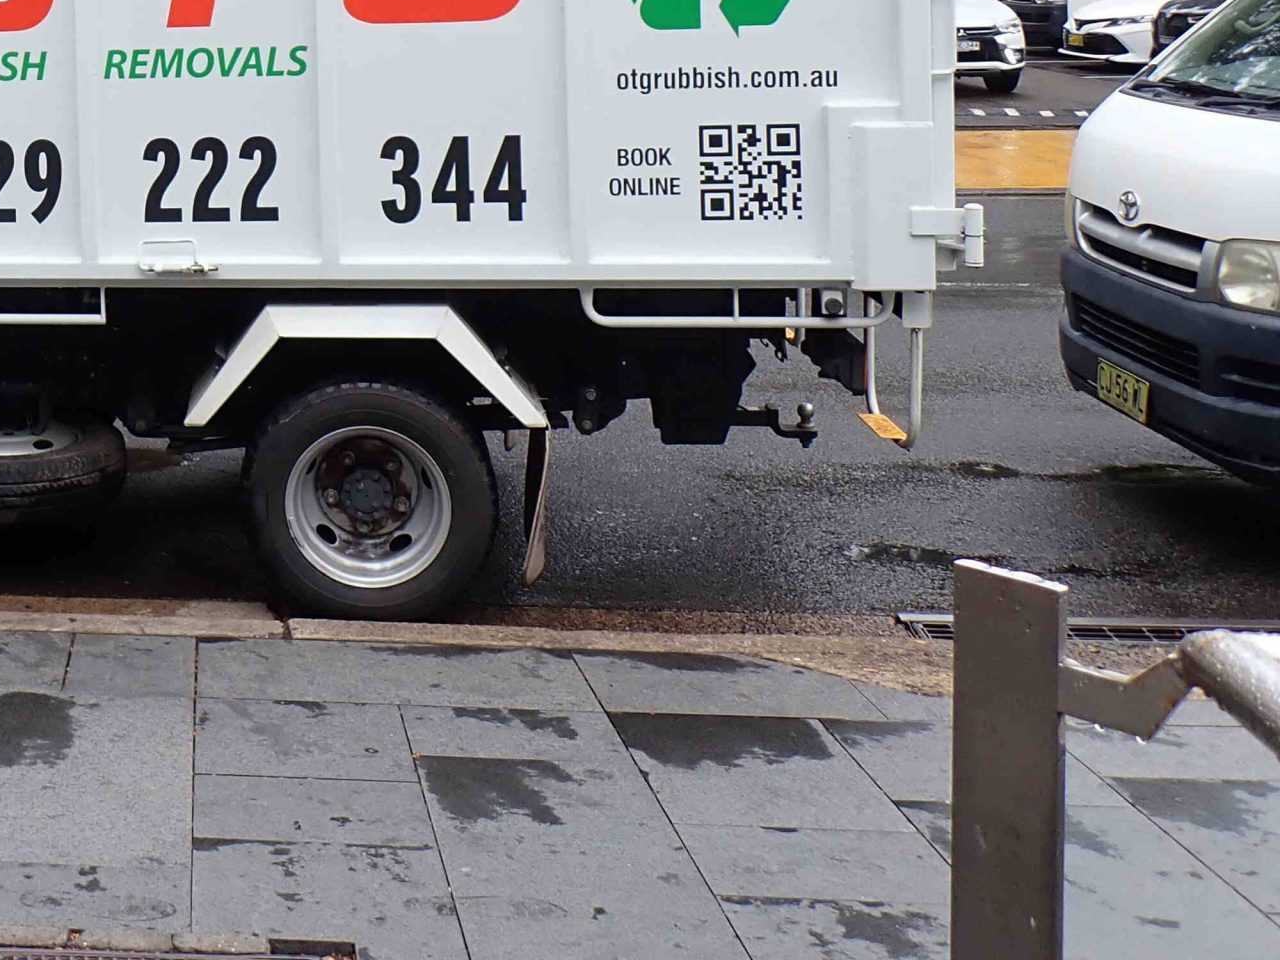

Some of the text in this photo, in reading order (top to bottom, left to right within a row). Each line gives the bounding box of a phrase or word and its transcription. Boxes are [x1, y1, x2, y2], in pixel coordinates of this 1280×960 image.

[103, 44, 309, 81] REMOVALS
[616, 66, 839, 95] otgrubbish.com.au
[616, 147, 672, 167] BOOK
[142, 135, 280, 224] 222
[379, 134, 528, 224] 344
[608, 176, 682, 197] ONLINE
